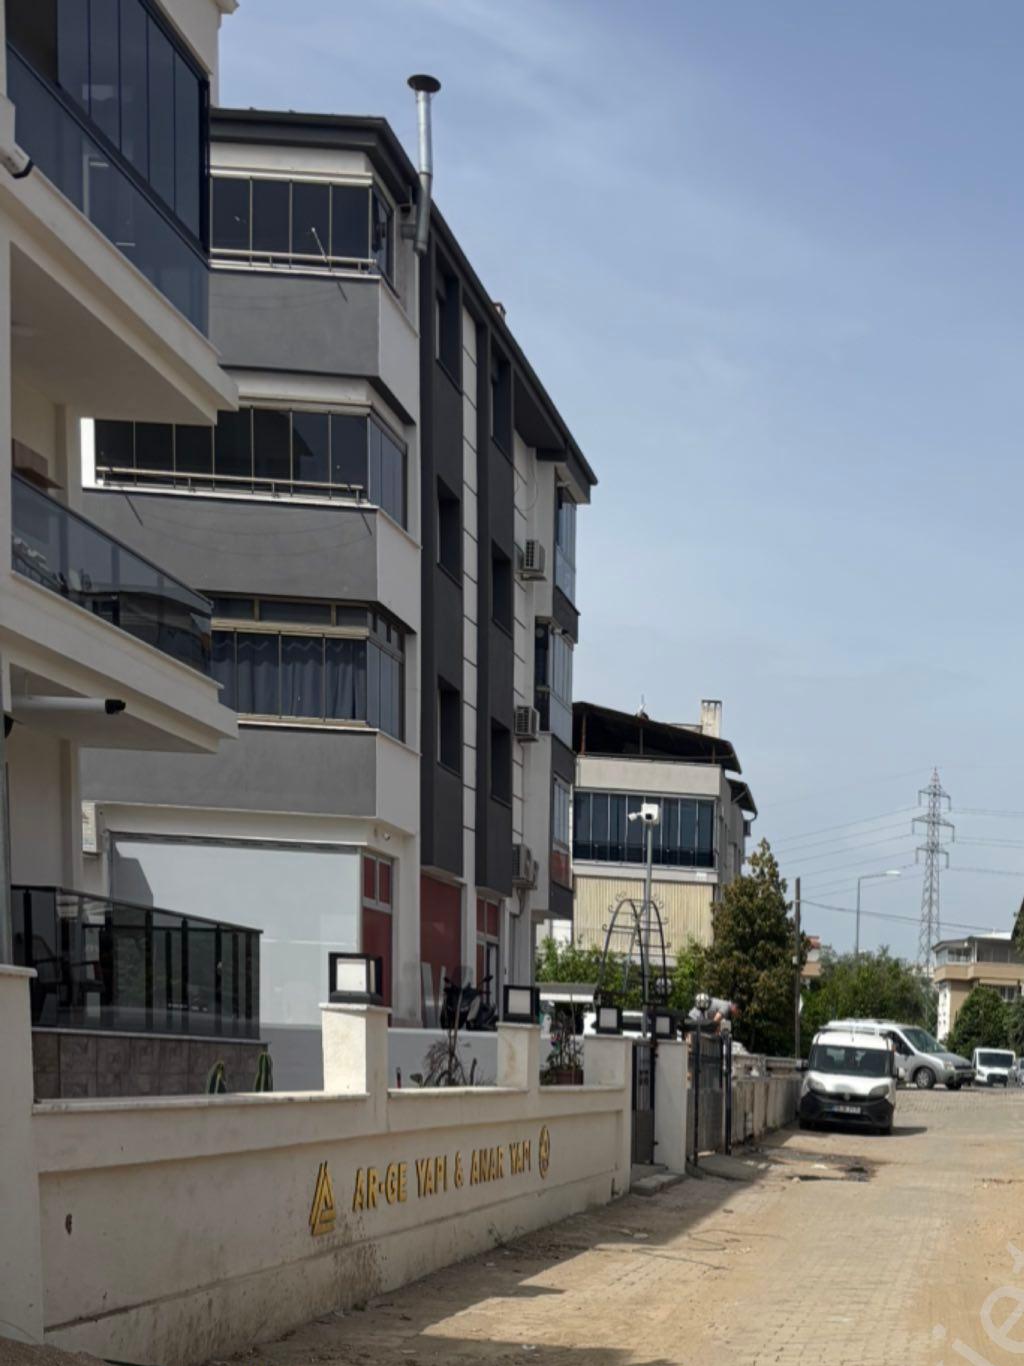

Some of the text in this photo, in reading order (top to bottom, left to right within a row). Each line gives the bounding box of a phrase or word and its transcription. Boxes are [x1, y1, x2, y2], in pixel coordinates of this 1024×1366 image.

[415, 1154, 448, 1198] YAPI
[454, 1151, 464, 1189] &
[509, 1140, 531, 1175] YAPI
